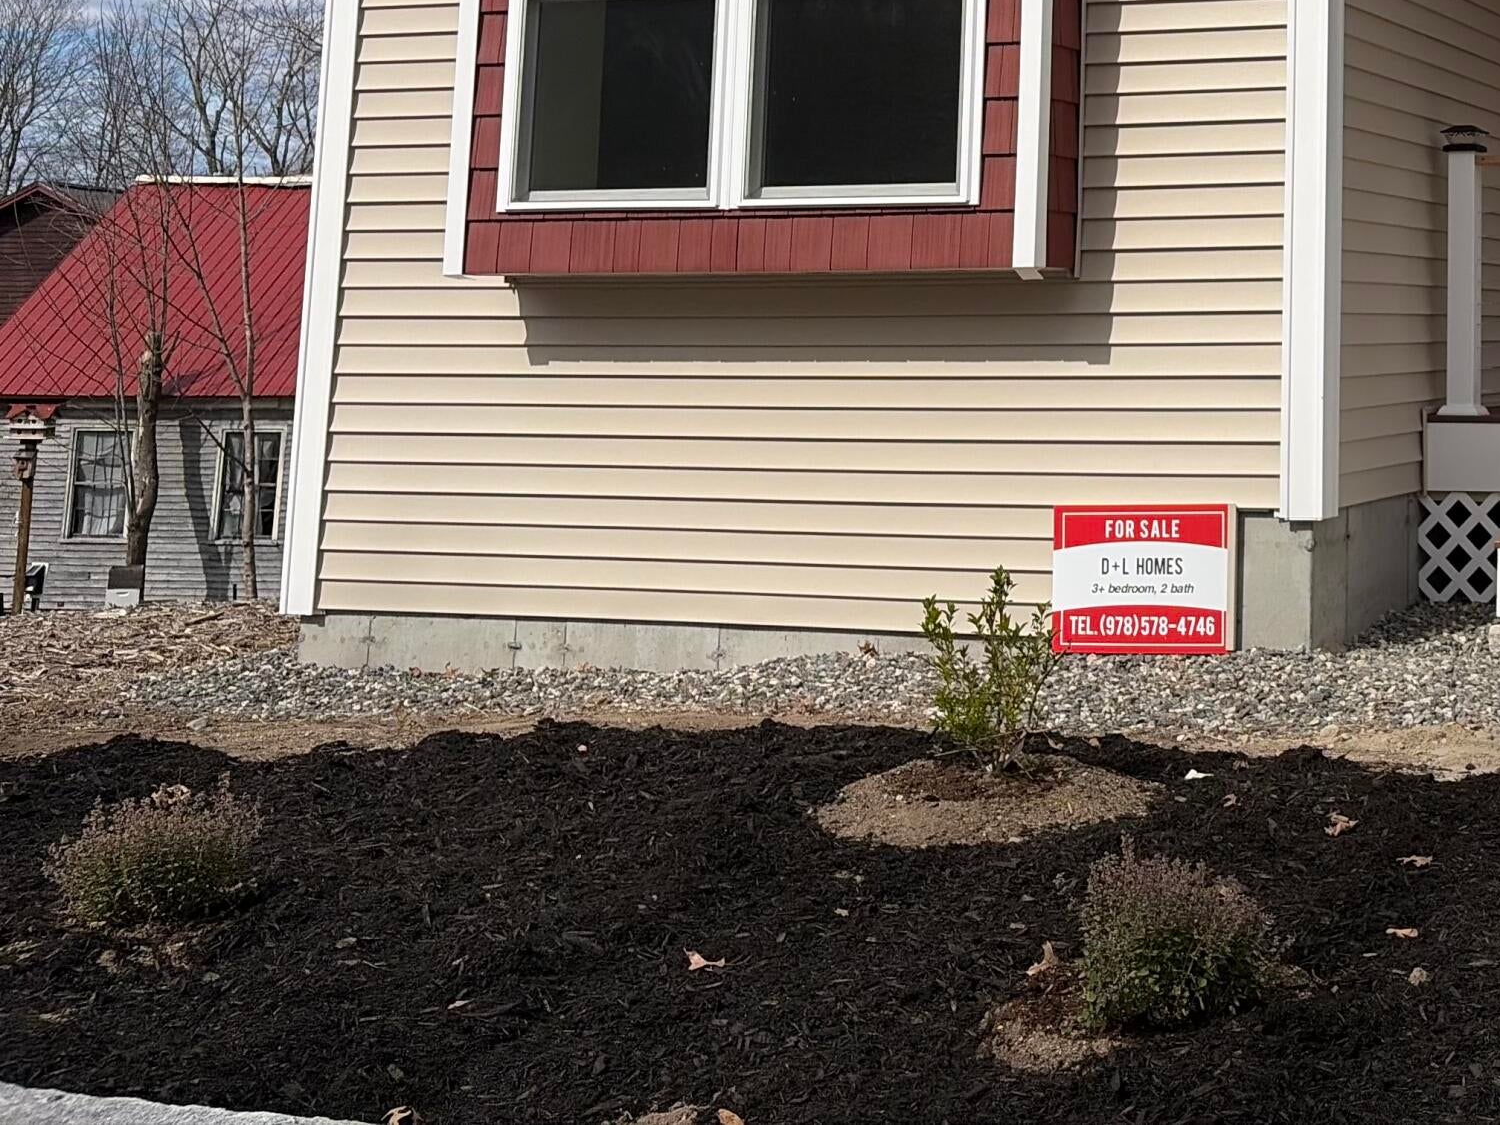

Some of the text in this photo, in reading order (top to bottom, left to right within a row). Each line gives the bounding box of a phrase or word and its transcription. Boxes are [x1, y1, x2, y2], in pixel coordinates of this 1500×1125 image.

[1105, 519, 1180, 538] FOR SALE
[1136, 557, 1183, 575] HOMES
[1092, 583, 1194, 595] 3+ bedroom, 2 bath
